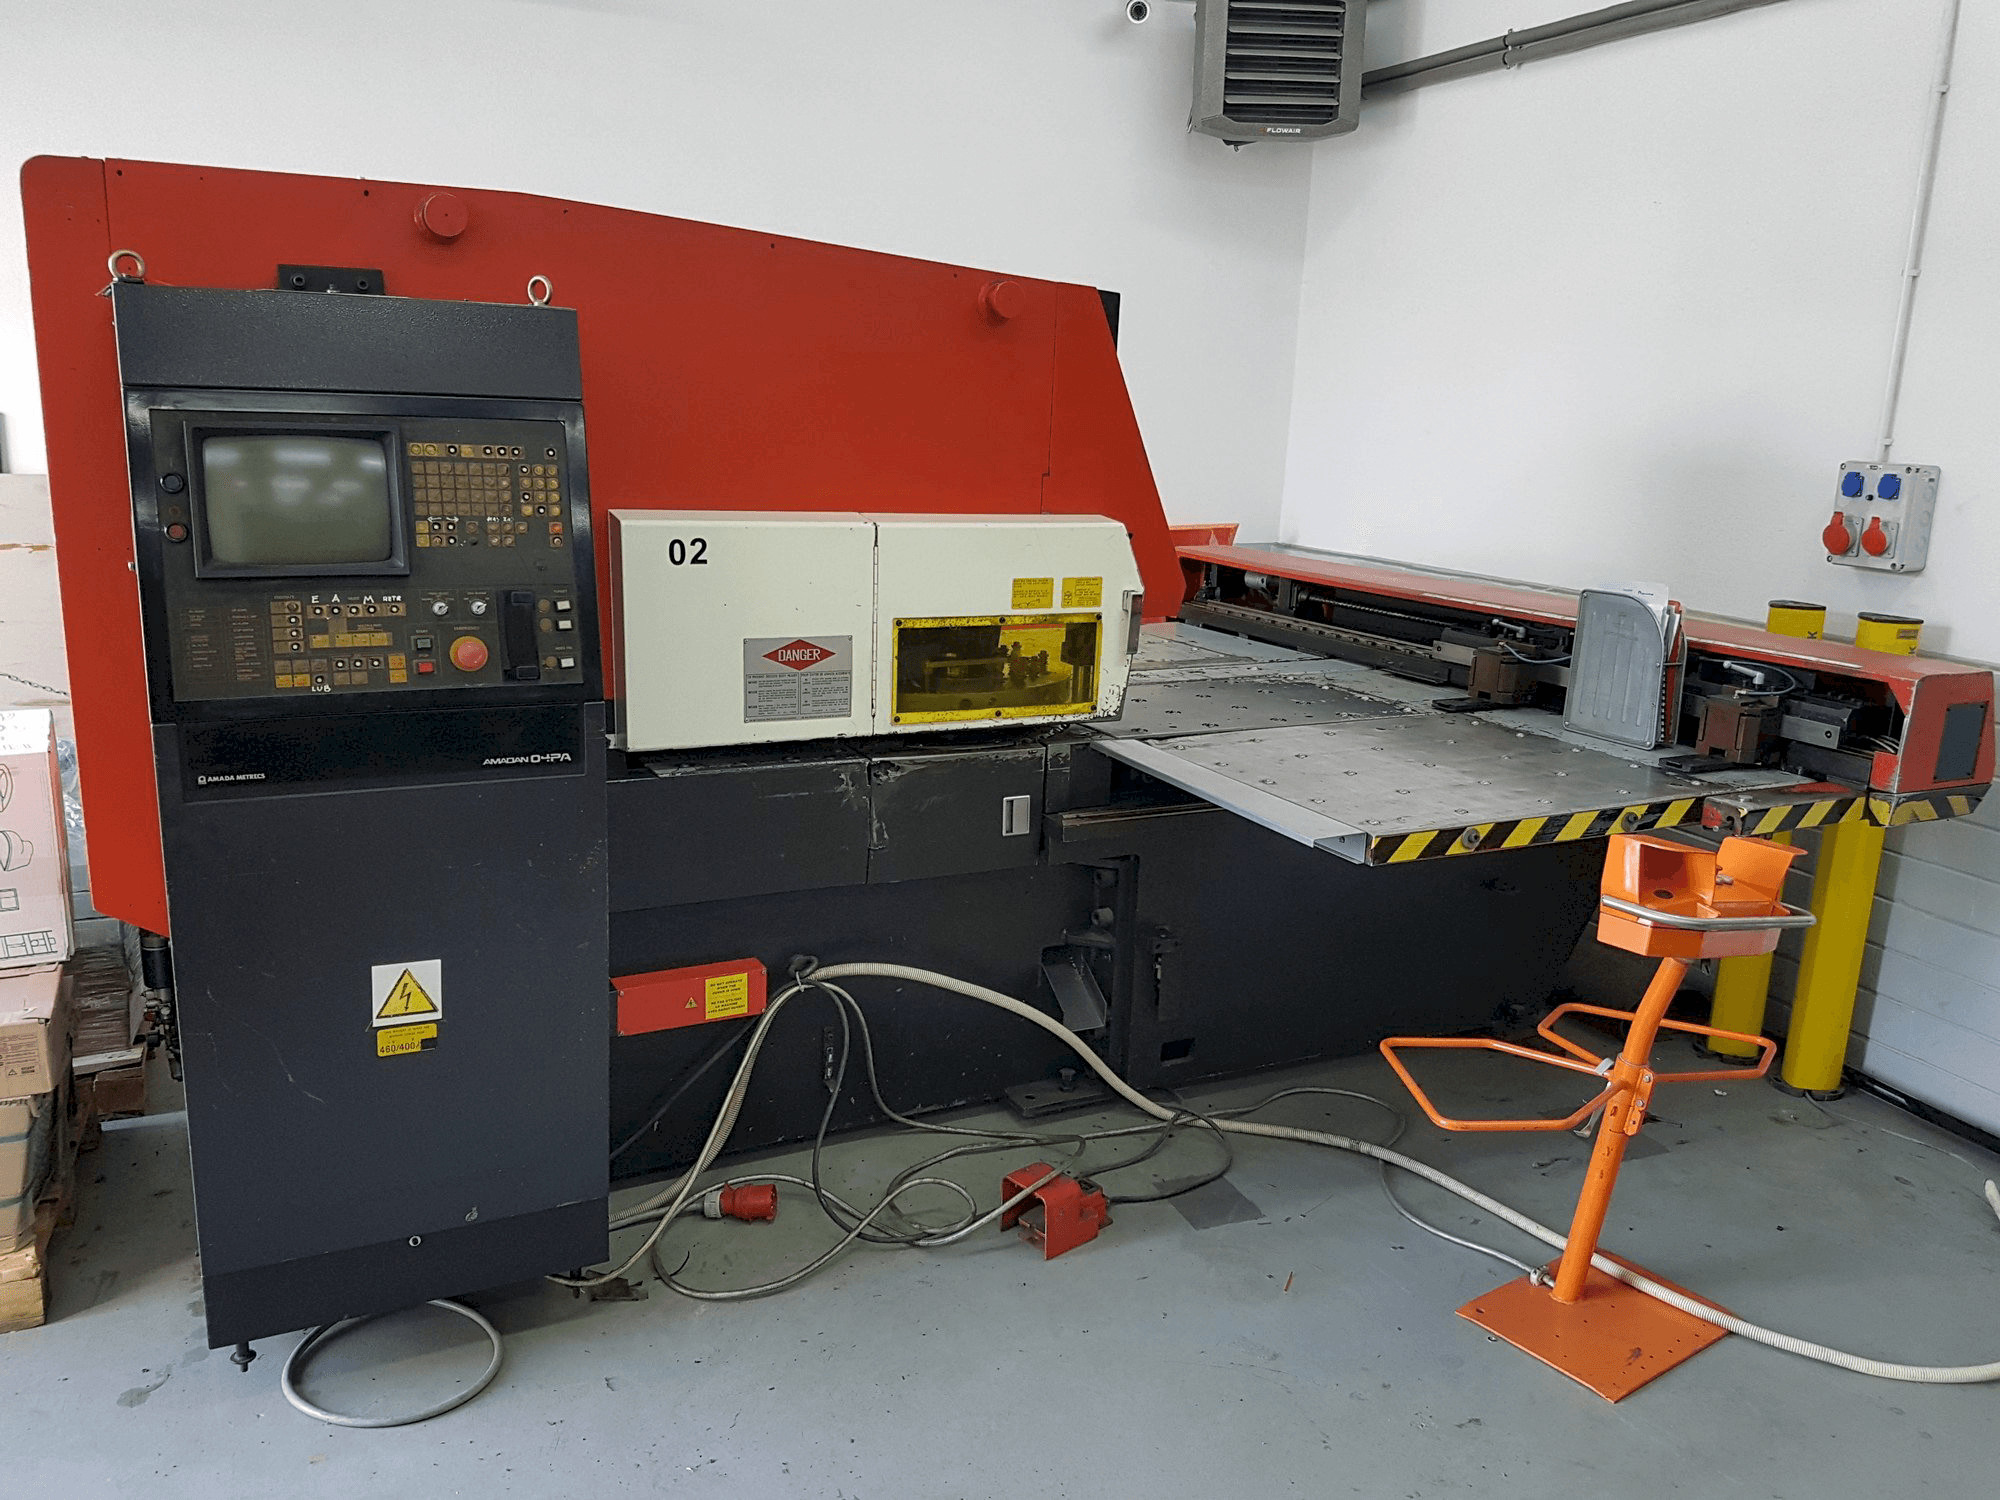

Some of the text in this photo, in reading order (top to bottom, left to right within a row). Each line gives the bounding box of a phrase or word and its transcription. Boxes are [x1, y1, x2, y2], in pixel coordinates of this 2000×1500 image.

[668, 537, 708, 566] 02
[311, 595, 320, 603] E
[331, 594, 340, 603] A
[363, 595, 375, 604] M
[778, 648, 821, 662] DANGER
